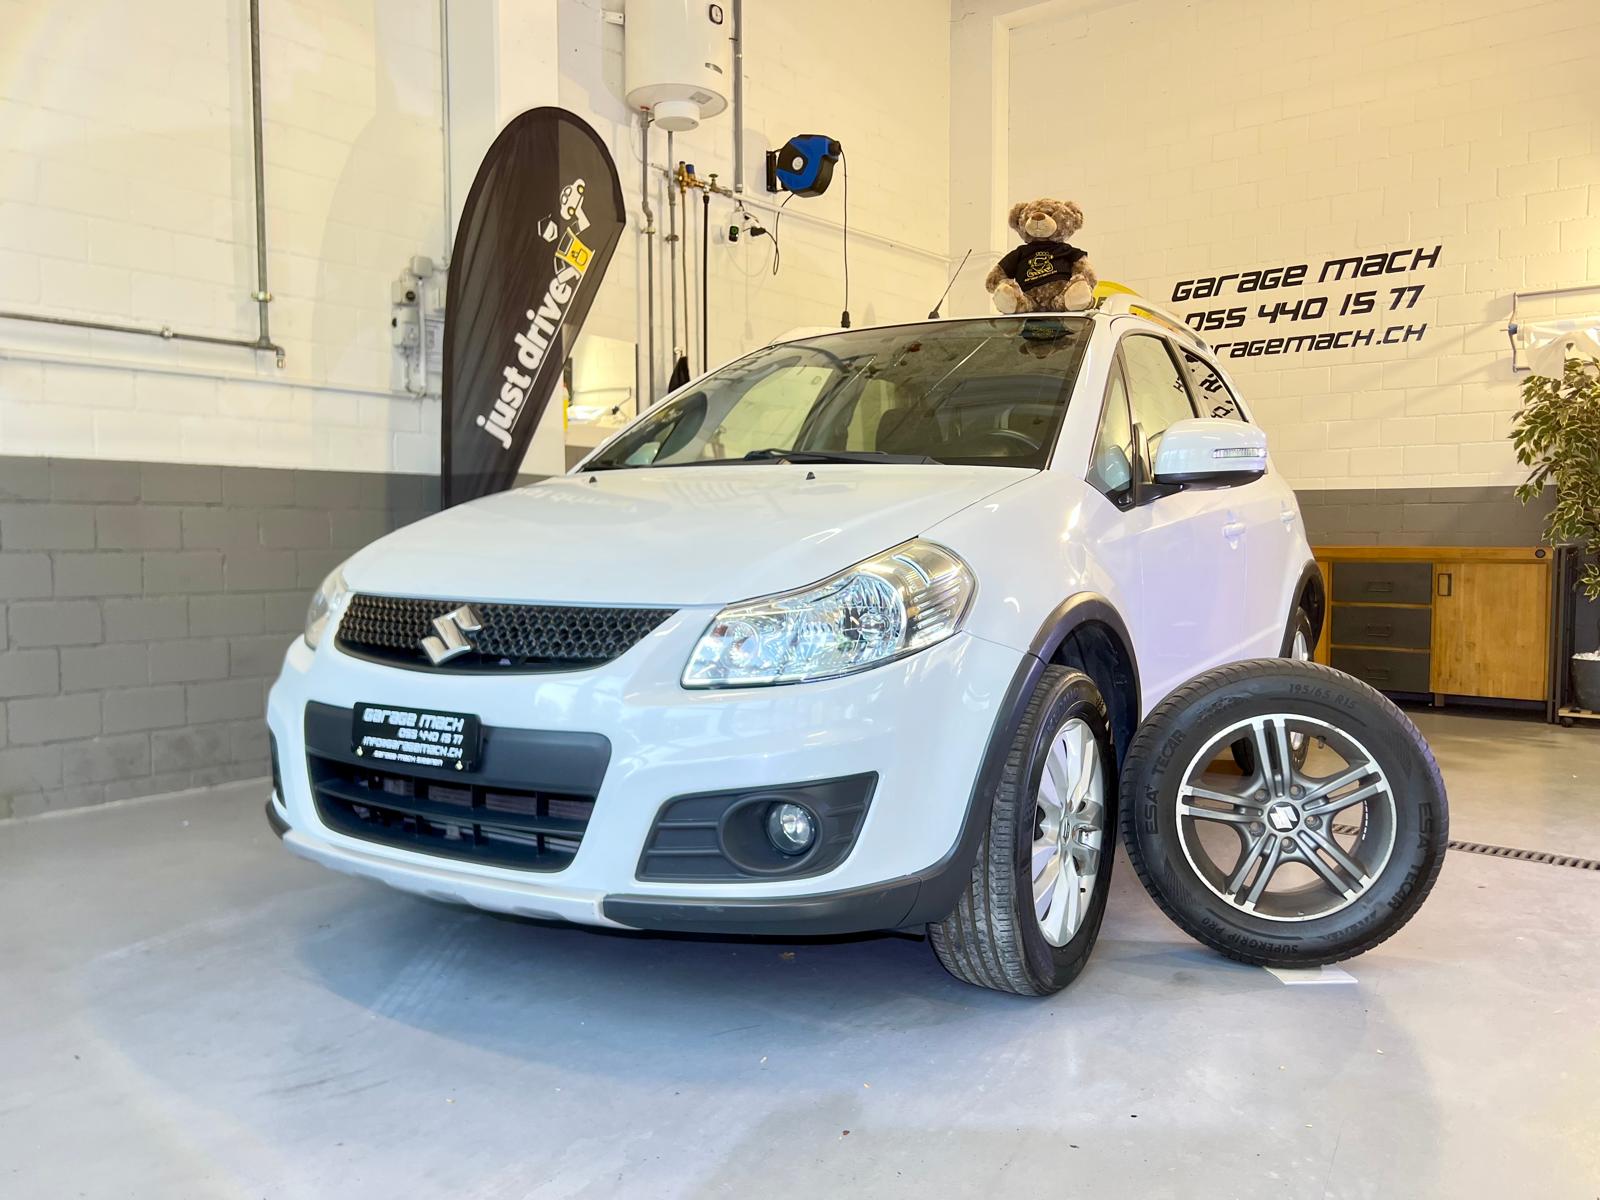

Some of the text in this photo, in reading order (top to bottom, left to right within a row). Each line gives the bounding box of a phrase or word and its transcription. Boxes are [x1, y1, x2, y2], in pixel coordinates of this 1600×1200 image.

[1184, 284, 1426, 332] 055 440 15 77
[476, 365, 532, 450] just
[1288, 683, 1356, 709] 195/65 R15
[397, 727, 419, 740] 055
[419, 729, 440, 743] 440
[1152, 728, 1186, 775] TECAR
[1201, 918, 1299, 954] SUPERGRIP PRO
